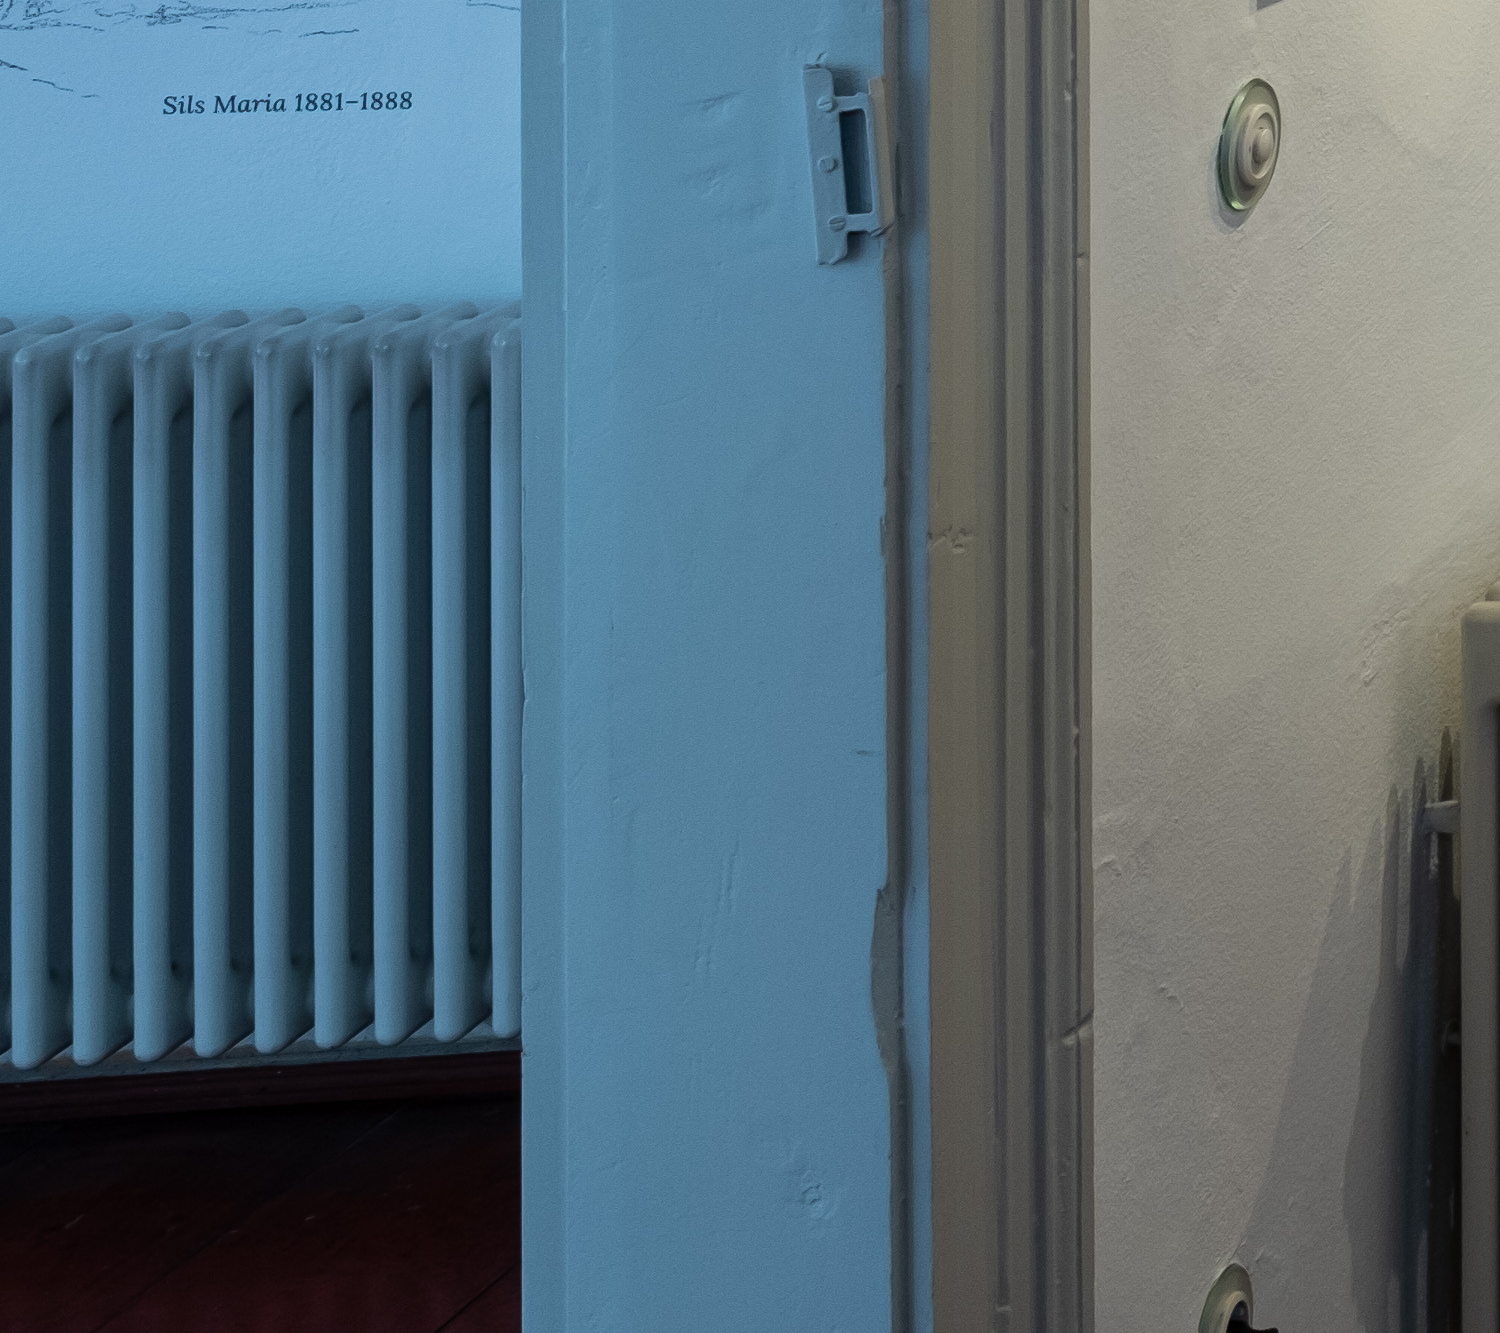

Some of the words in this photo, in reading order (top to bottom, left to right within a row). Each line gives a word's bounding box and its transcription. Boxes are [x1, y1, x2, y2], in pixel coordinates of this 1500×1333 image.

[163, 95, 205, 115] Sils
[212, 93, 286, 114] Maria
[295, 91, 413, 112] 1881–1888
